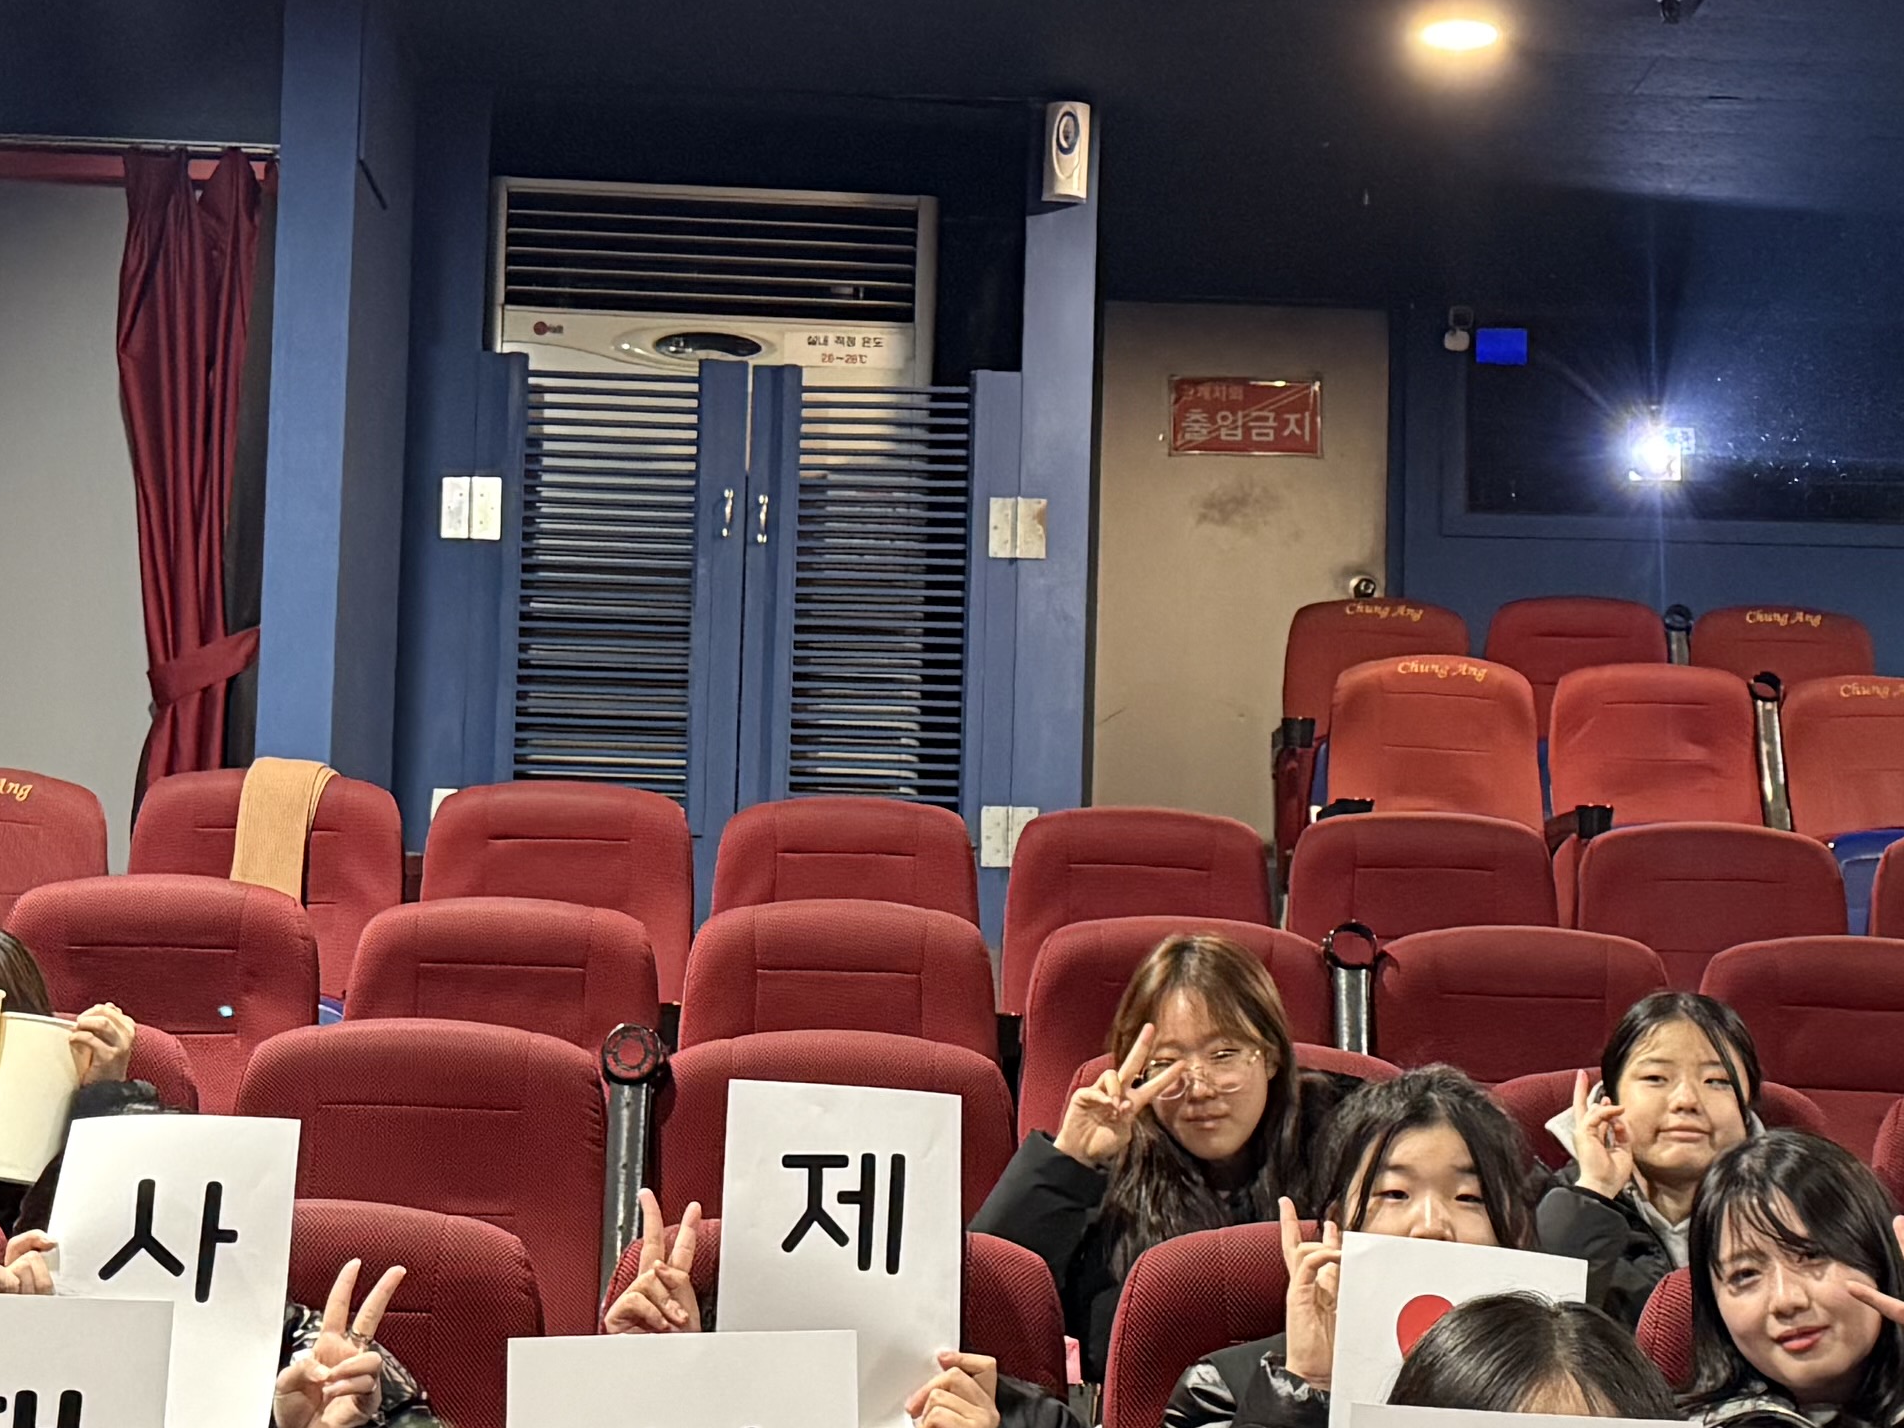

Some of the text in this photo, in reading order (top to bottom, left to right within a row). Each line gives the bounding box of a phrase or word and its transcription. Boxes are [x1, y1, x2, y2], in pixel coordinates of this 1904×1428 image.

[1182, 409, 1310, 444] 출입금지
[1345, 602, 1423, 622] Chung Ang
[1746, 609, 1822, 627] Chung Ang
[1397, 659, 1487, 682] Chung Ang
[1840, 681, 1890, 699] Chung
[780, 1152, 906, 1276] 제
[98, 1178, 238, 1304] 사
